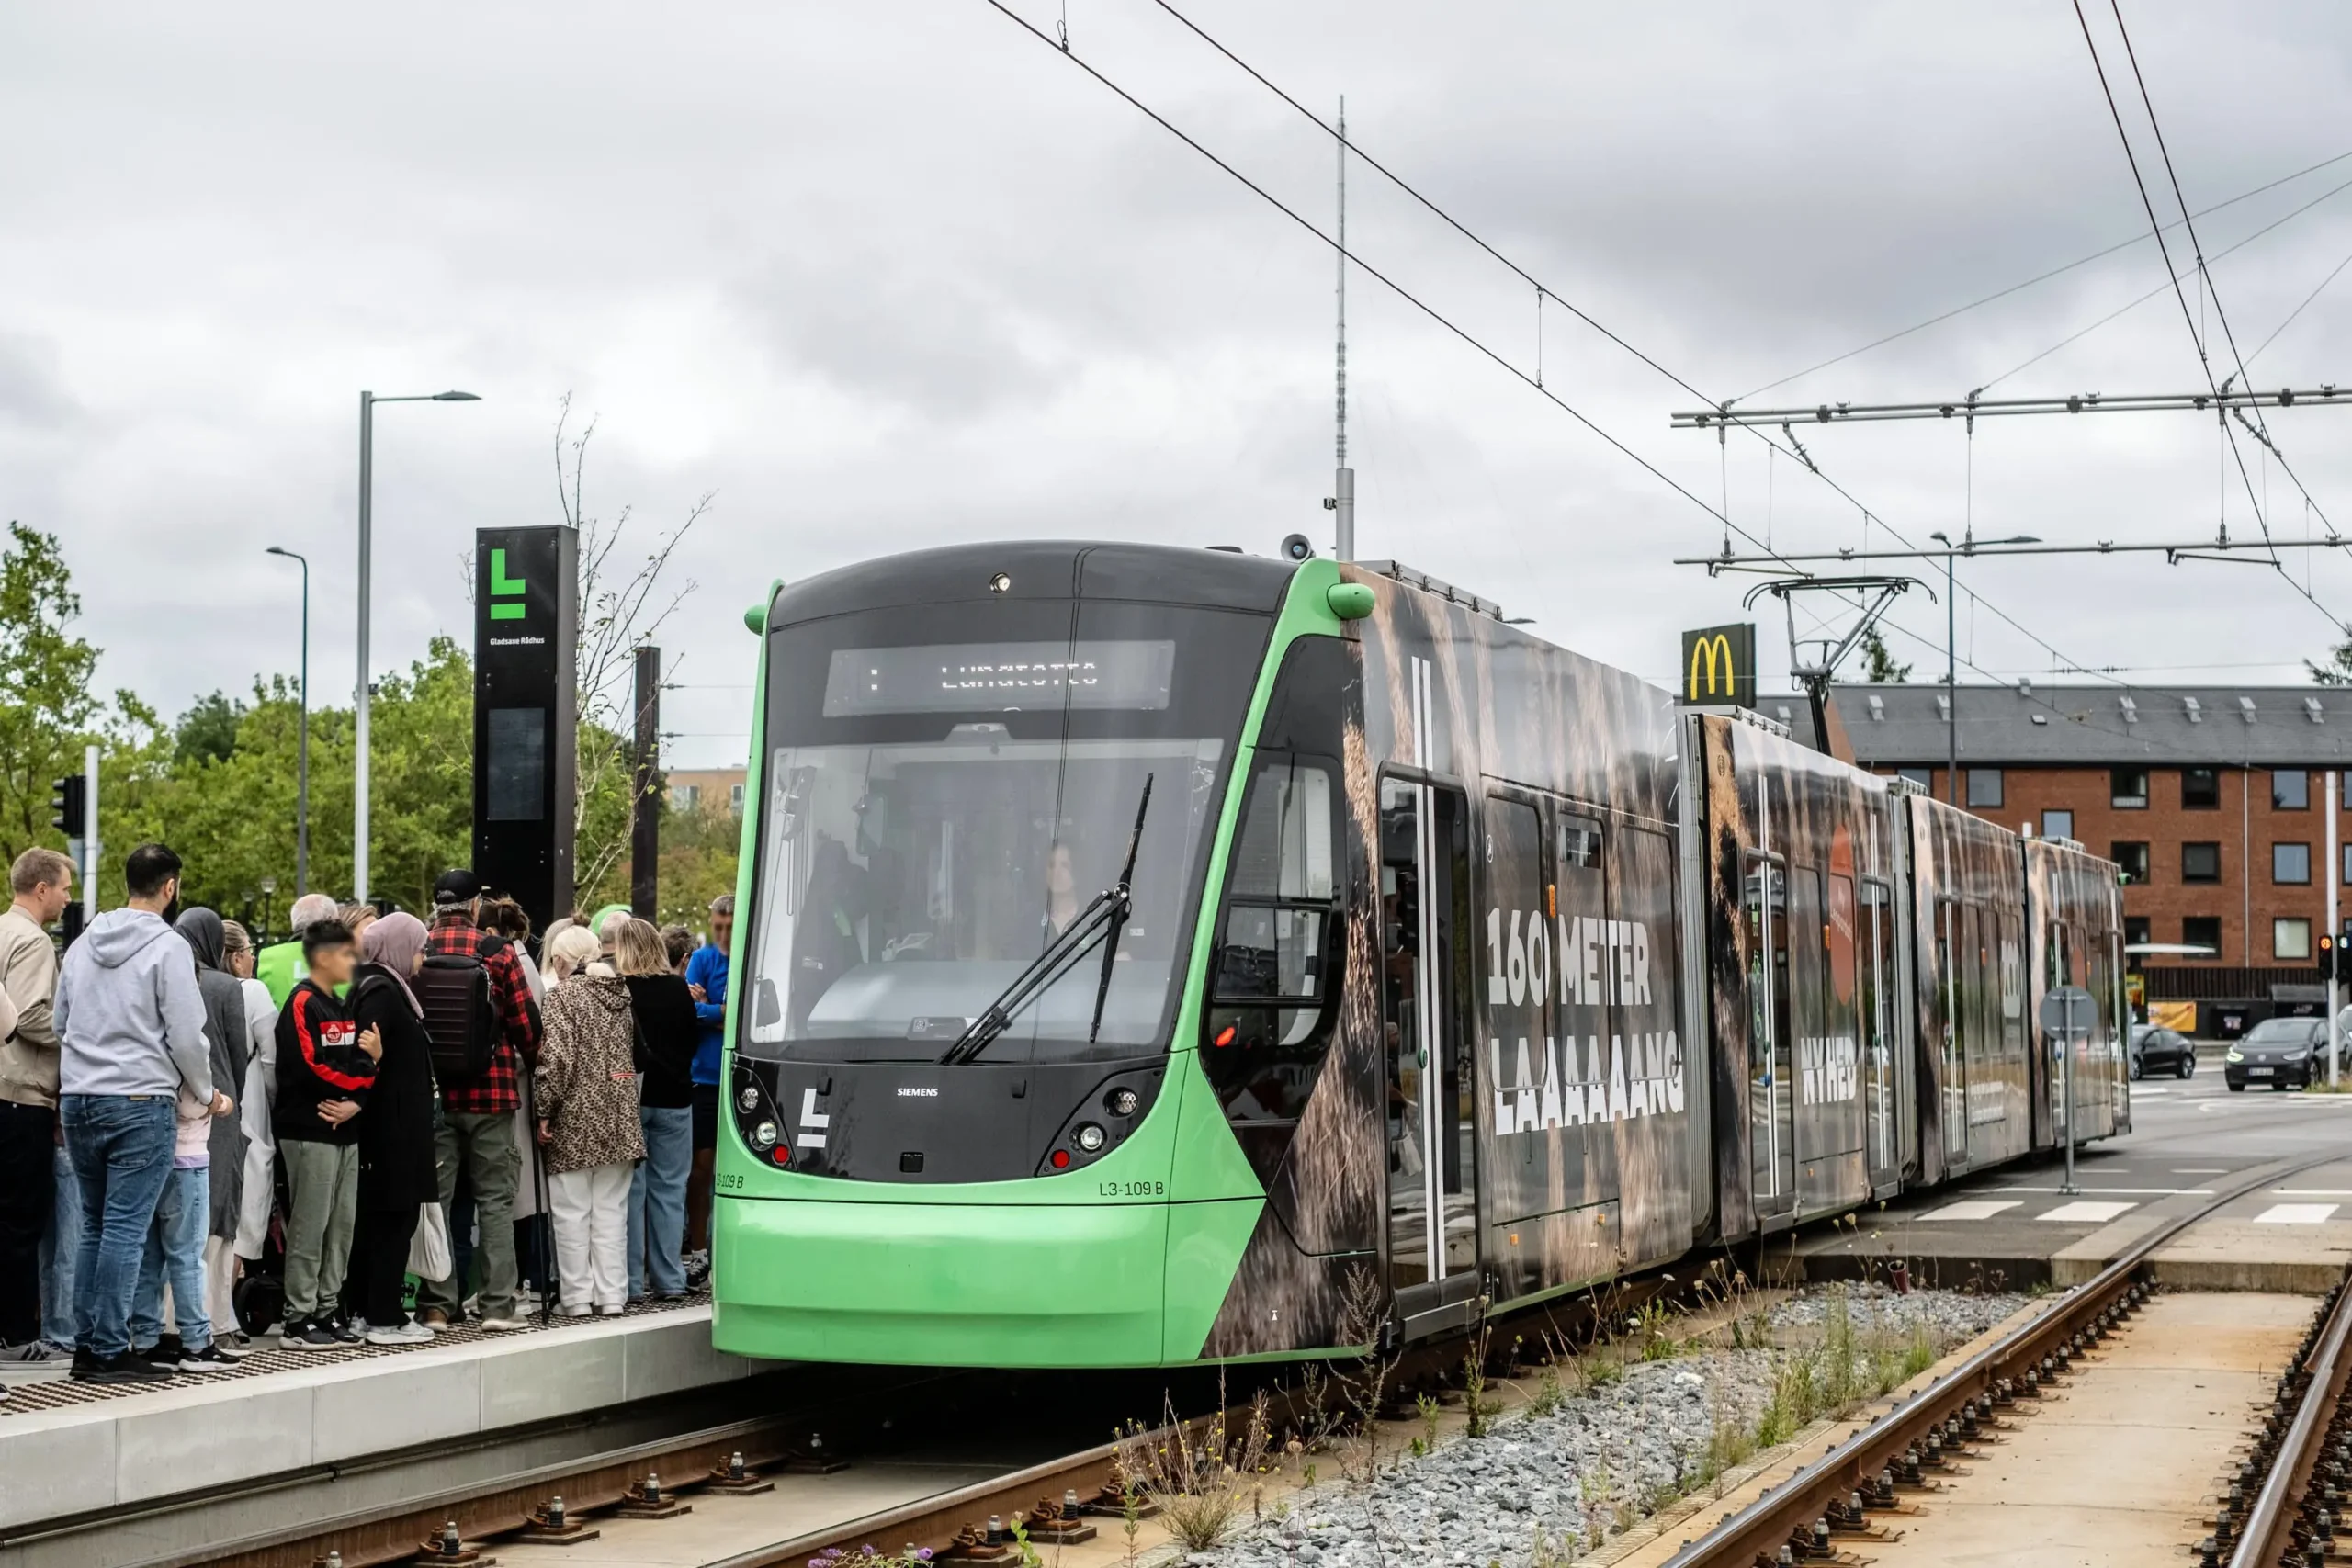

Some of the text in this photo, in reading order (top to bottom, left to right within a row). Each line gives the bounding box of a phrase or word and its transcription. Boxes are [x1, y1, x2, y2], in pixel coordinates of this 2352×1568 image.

[521, 636, 545, 645] Rådhus
[1487, 908, 1652, 1008] 160 METER
[1800, 1037, 1858, 1106] NYHED
[897, 1088, 939, 1097] SIEMENS
[736, 1175, 744, 1189] B
[1099, 1181, 1164, 1196] L3-109 B
